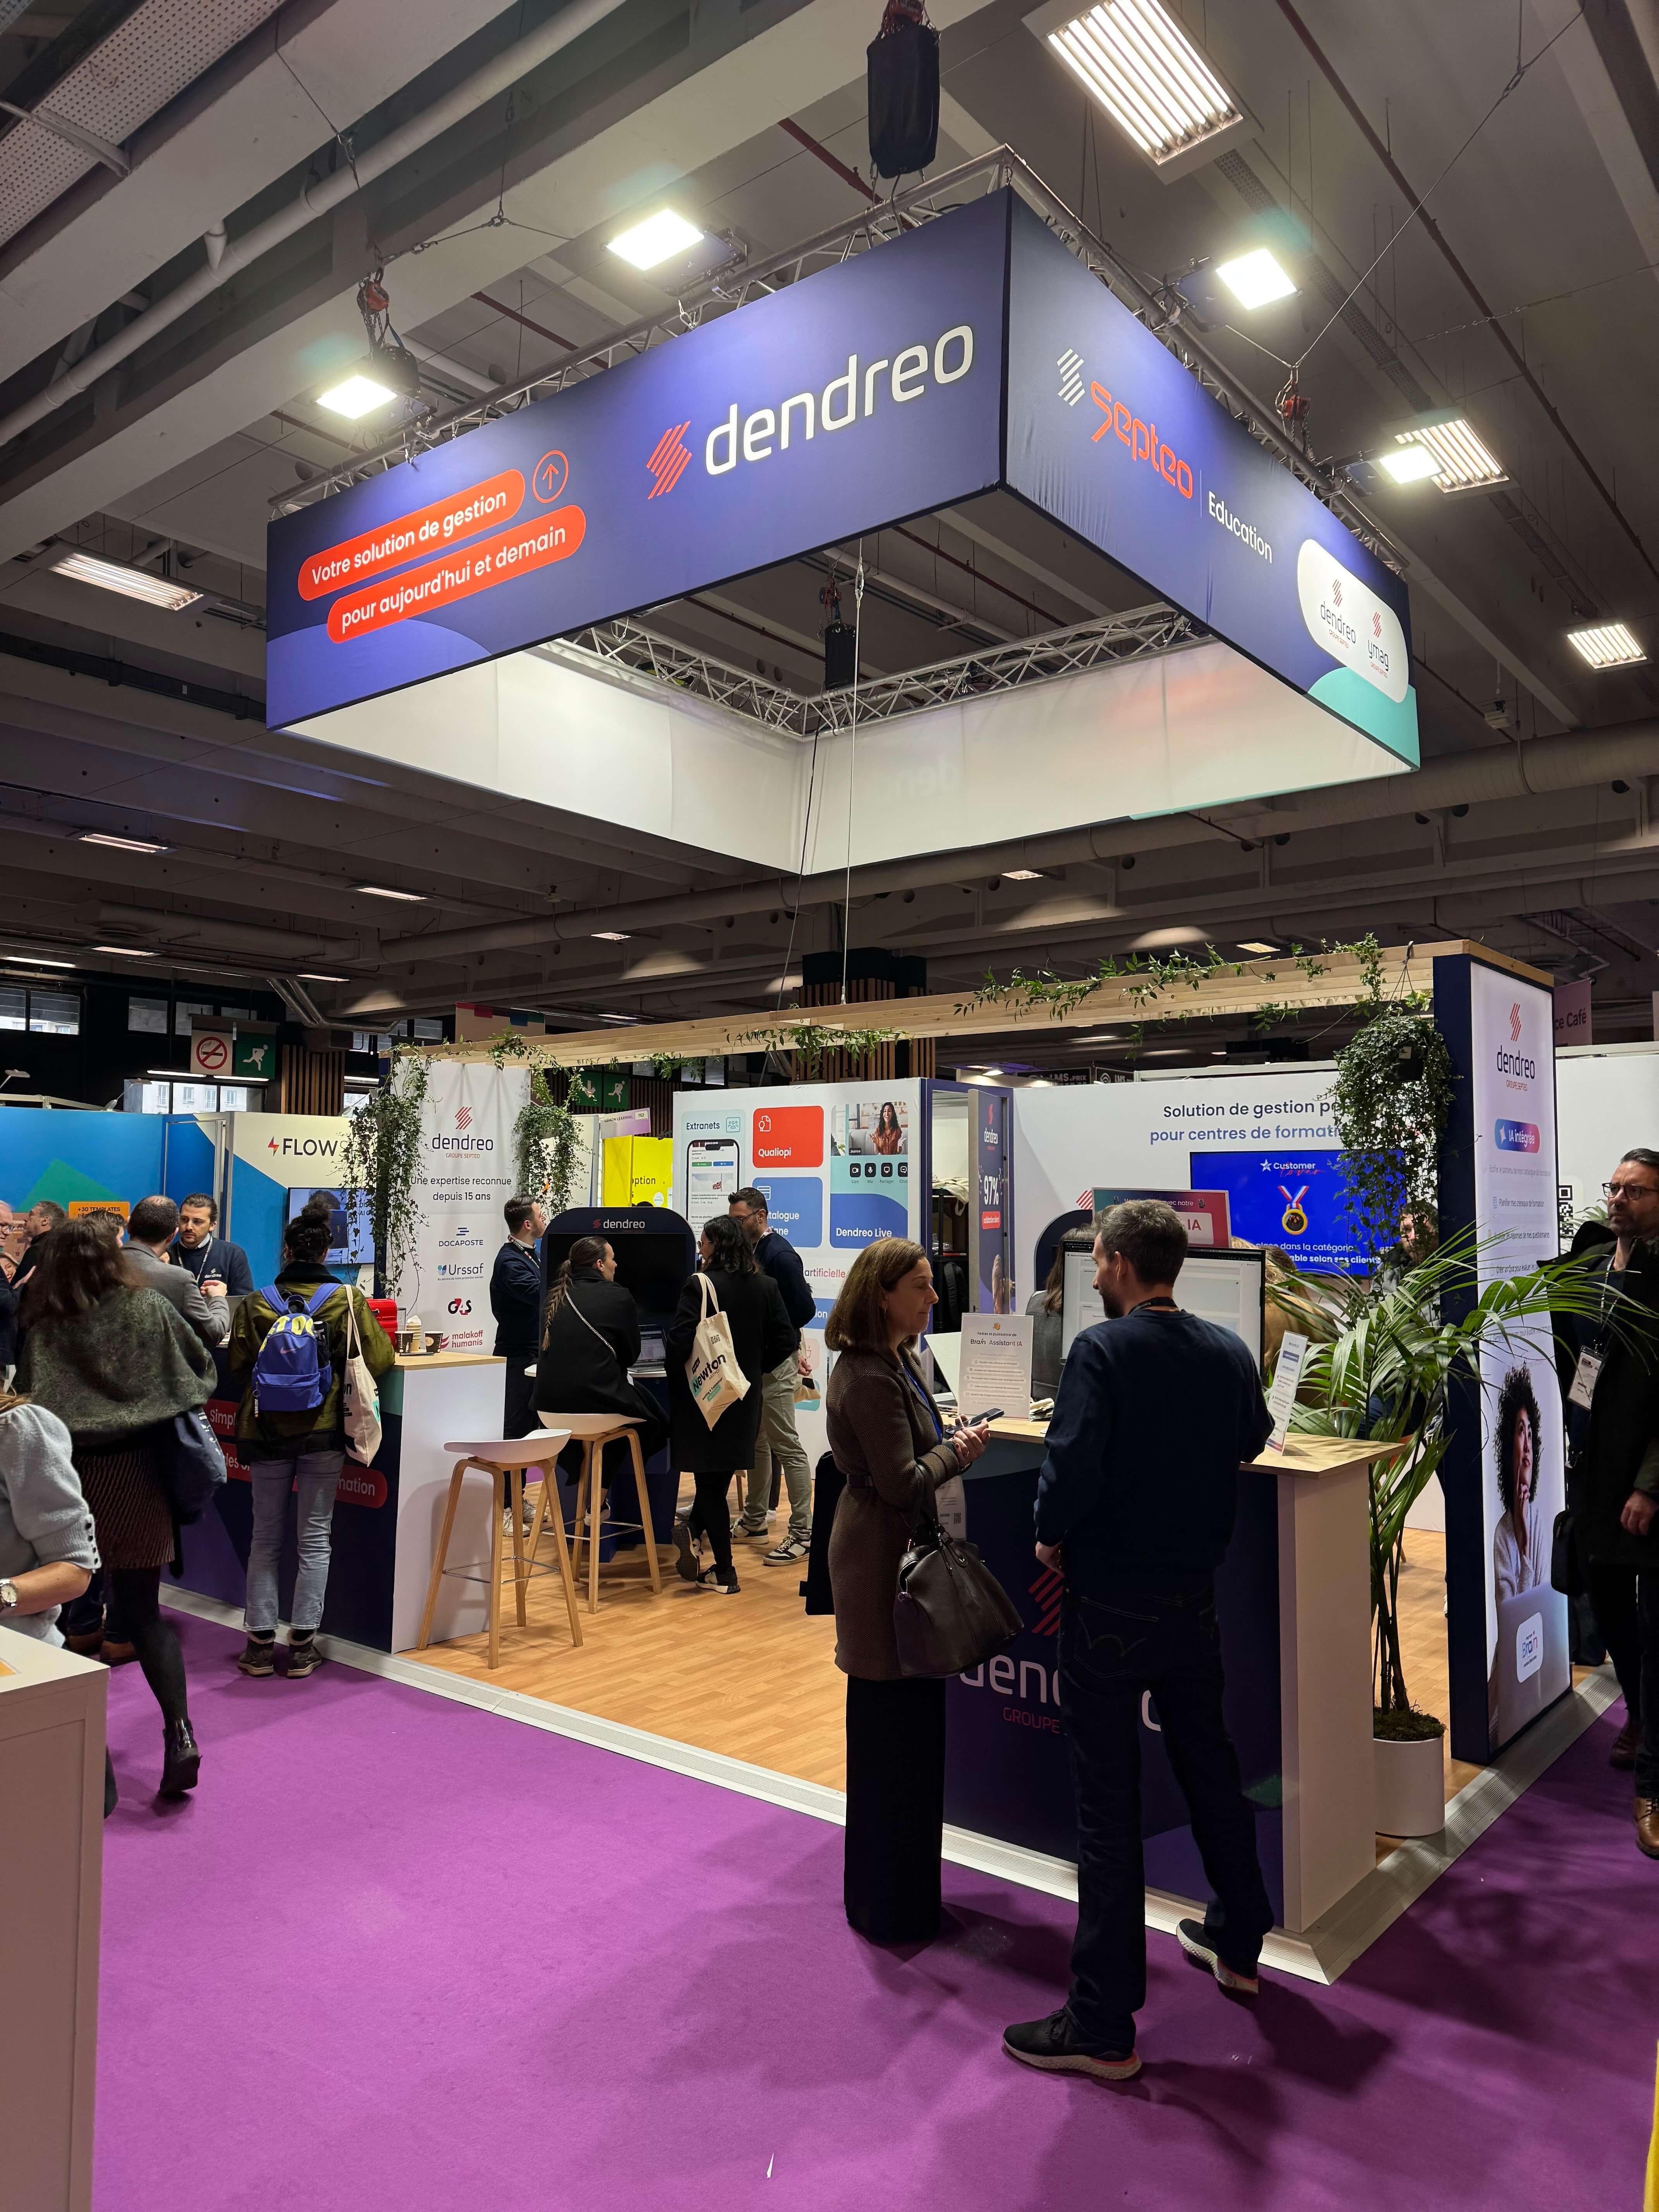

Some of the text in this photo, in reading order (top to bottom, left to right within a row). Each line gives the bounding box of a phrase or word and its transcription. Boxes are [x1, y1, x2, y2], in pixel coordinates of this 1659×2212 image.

[706, 325, 973, 475] dendreo
[1208, 491, 1273, 563] Education
[312, 491, 507, 584] Votre solution de gestion
[342, 527, 566, 634] pour aujourd'hui et demain
[1321, 601, 1356, 644] dendreo
[1368, 640, 1389, 672] ymag
[1555, 1007, 1587, 1030] ce Café
[1497, 1045, 1535, 1079] dendreo
[1163, 1100, 1339, 1118] Solution de gestion po
[686, 1121, 720, 1130] Extranets
[432, 1133, 493, 1151] dendreo
[984, 1128, 998, 1144] dendreo
[1150, 1125, 1338, 1145] pour centres de formati
[1509, 1129, 1535, 1147] IA intégrée
[758, 1147, 792, 1157] Qualiopi
[431, 1176, 470, 1187] expertise
[632, 1176, 656, 1187] ption
[984, 1175, 999, 1205] 97%
[433, 1192, 462, 1203] depuis
[603, 1219, 645, 1228] dendreo
[768, 1211, 799, 1222] talogue
[1187, 1219, 1202, 1230] IA
[836, 1228, 892, 1238] Dendreo Live
[449, 1263, 484, 1275] Urssaf
[805, 1268, 846, 1278] artificielle
[448, 1298, 472, 1315] G4S
[815, 1310, 828, 1318] ion
[452, 1330, 483, 1340] malakoff
[452, 1338, 483, 1348] humanis
[693, 1354, 726, 1393] Newton
[210, 1409, 236, 1429] Simpl
[338, 1477, 375, 1496] mation
[1003, 1707, 1060, 1734] GROUPE
